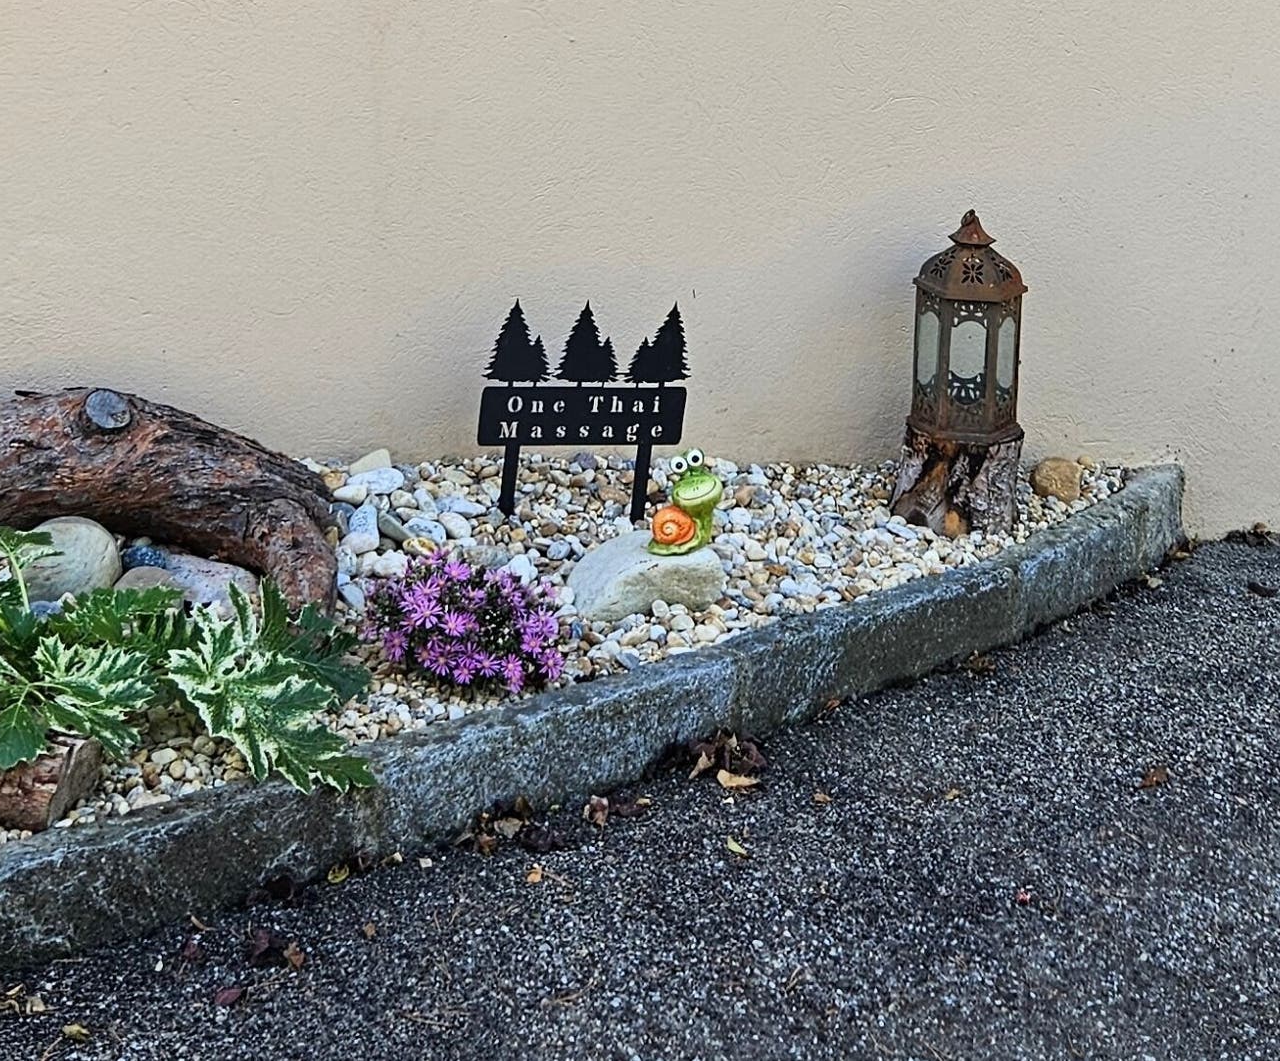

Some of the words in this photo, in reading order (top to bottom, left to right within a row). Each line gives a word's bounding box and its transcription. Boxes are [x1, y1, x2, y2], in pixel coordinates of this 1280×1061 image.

[507, 396, 566, 413] One
[588, 395, 661, 413] Thai
[498, 421, 663, 442] Massage
